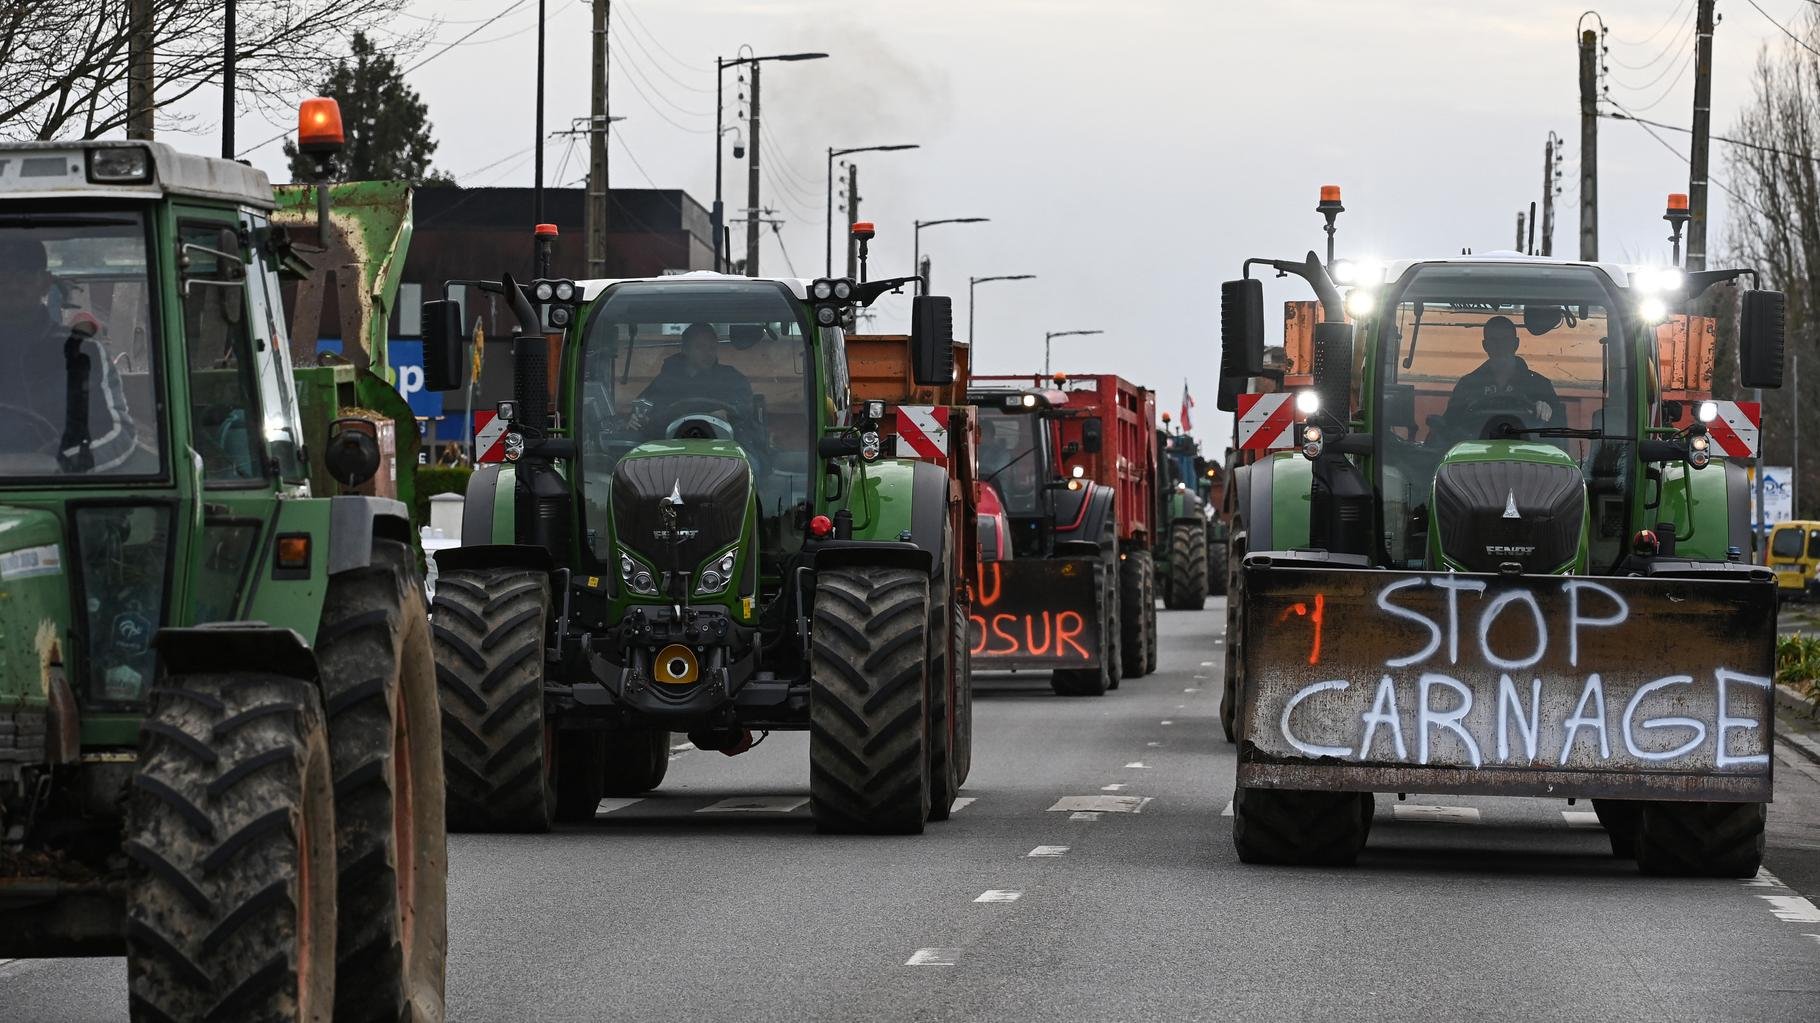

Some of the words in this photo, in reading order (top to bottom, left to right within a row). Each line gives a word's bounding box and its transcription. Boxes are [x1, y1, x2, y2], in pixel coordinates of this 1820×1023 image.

[1486, 545, 1535, 555] FENDT
[1377, 573, 1629, 669] STOP
[1281, 667, 1771, 769] CARNAGE
